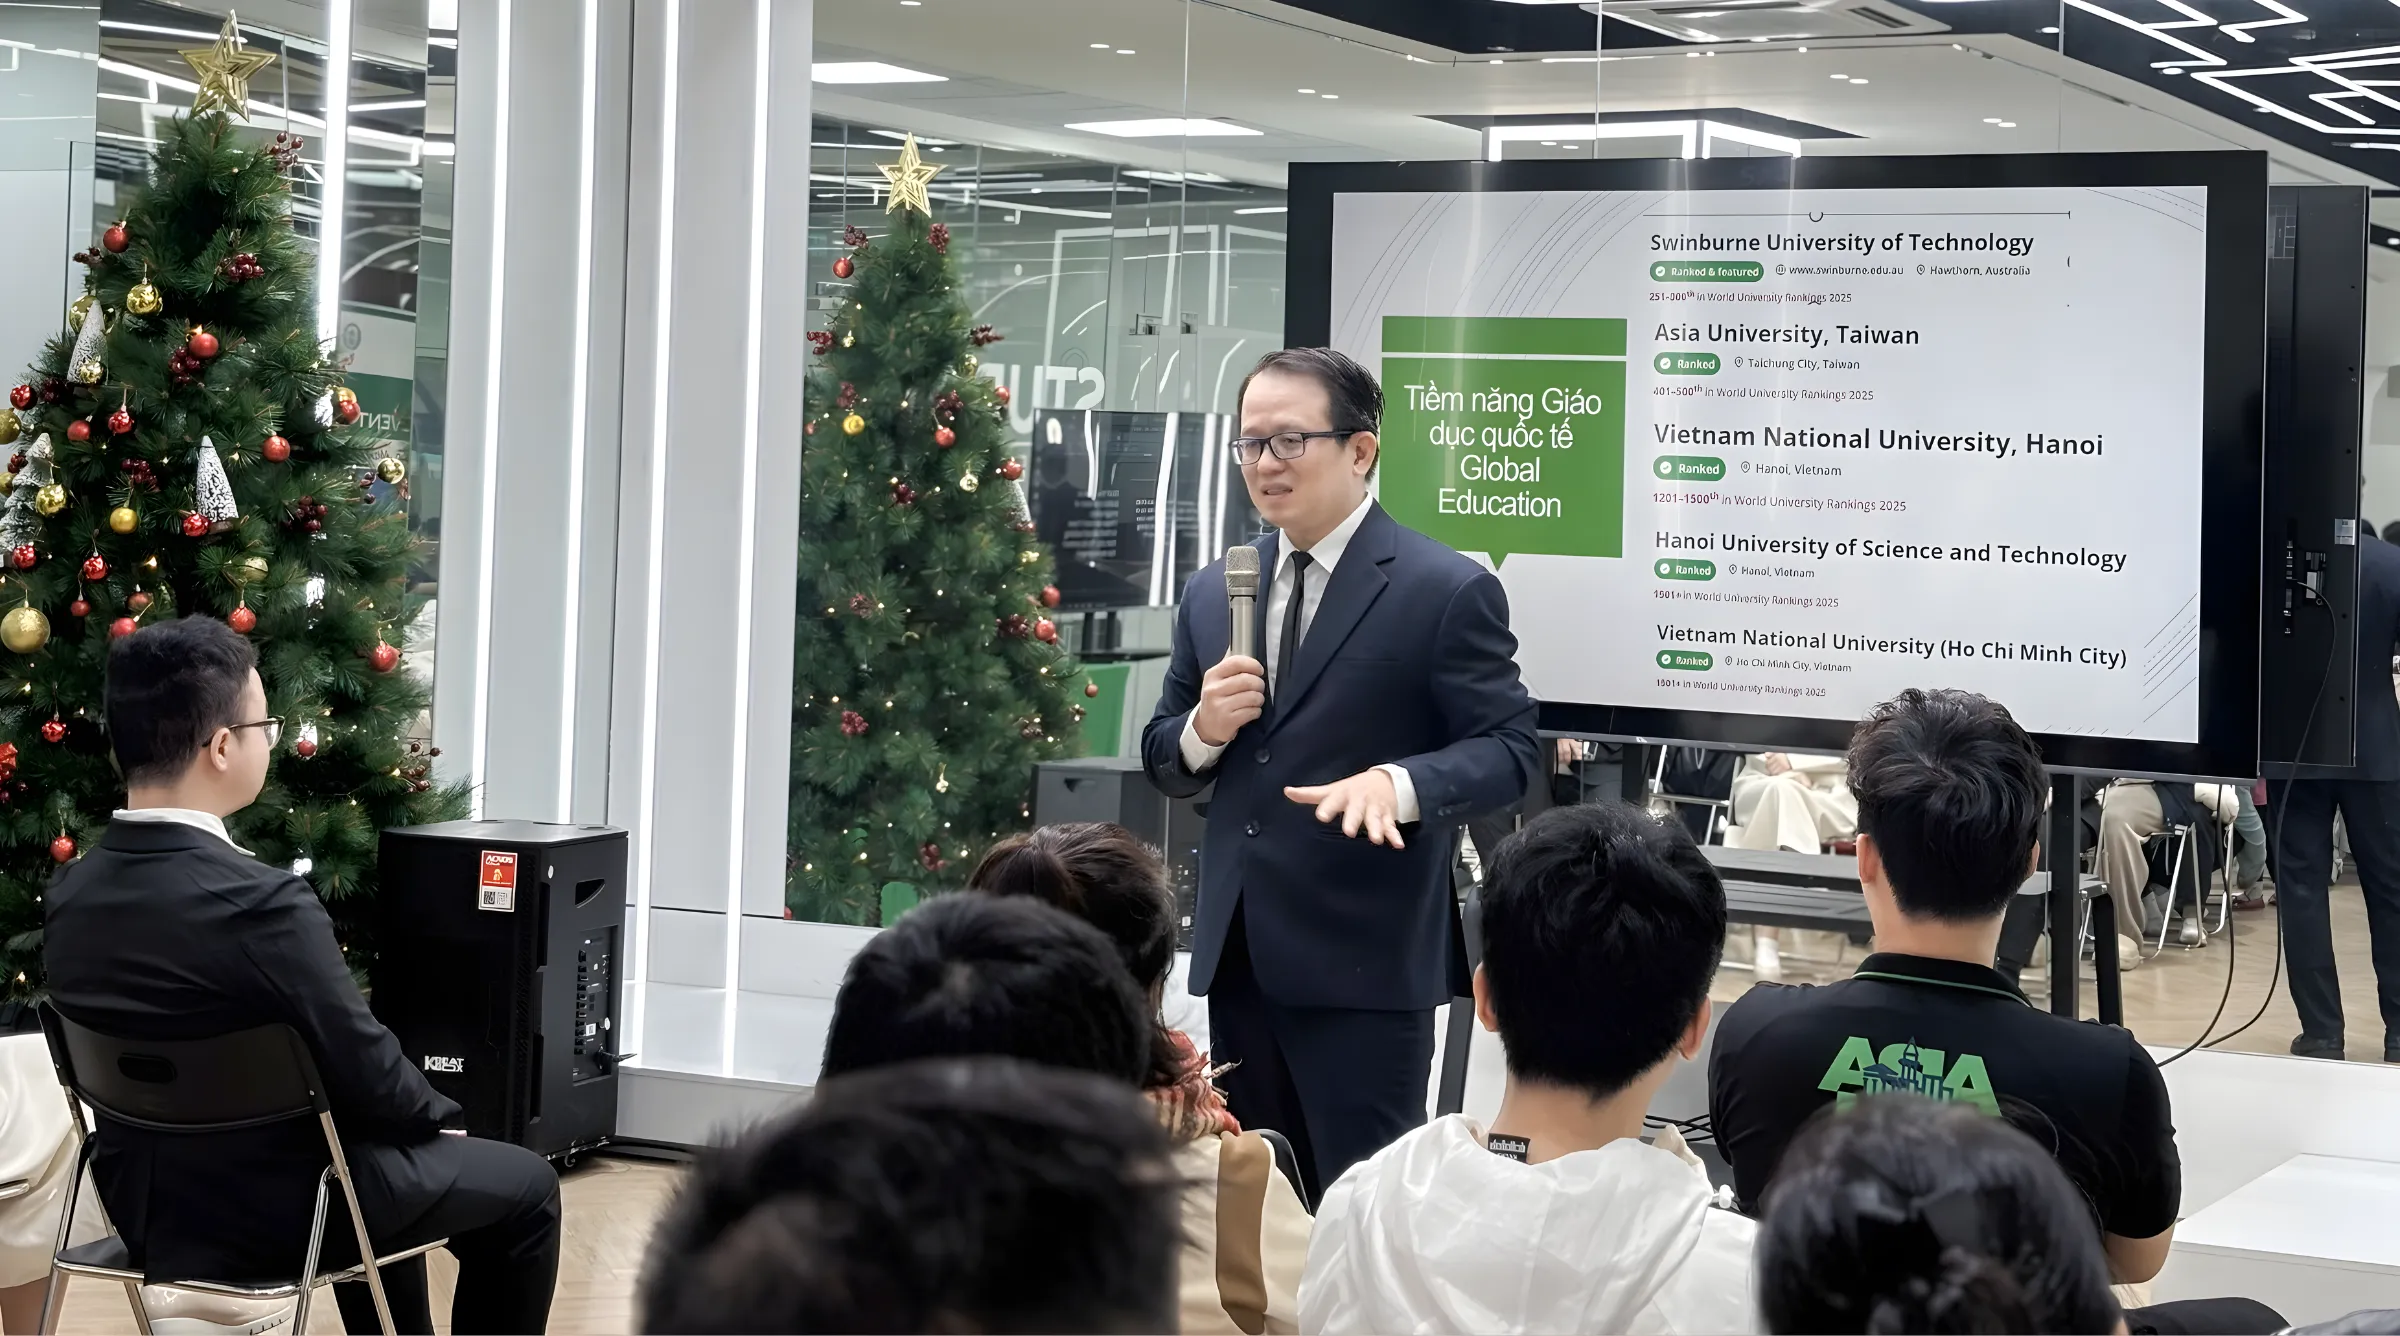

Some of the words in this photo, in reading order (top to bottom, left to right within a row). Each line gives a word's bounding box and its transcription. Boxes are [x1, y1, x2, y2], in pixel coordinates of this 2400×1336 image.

[1650, 233, 1761, 251] Swinburne
[1767, 232, 1876, 257] University
[1881, 232, 1905, 251] of
[1908, 232, 2035, 257] Technology
[1930, 265, 1983, 276] Hawthorn,
[1984, 265, 2031, 276] Australia
[1696, 292, 1706, 302] in
[1707, 292, 1735, 302] World
[1829, 293, 1852, 303] 2025
[1654, 322, 1700, 342] Asia
[1708, 323, 1829, 349] University,
[1835, 324, 1919, 345] Taiwan
[1677, 358, 1716, 370] Ranked
[1747, 357, 1795, 371] Taichung
[1797, 358, 1820, 372] City,
[1822, 358, 1860, 370] Taiwan
[1404, 380, 1463, 411] Tiềm
[1472, 386, 1534, 420] năng
[1542, 387, 1602, 415] Giáo
[1704, 386, 1714, 397] in
[1716, 387, 1746, 398] World
[1748, 388, 1799, 402] University
[1801, 389, 1846, 403] Rankings
[1848, 390, 1874, 401] 2025
[1430, 420, 1474, 449] dục
[1482, 415, 1543, 453] quốc
[1550, 417, 1573, 448] tế
[1653, 423, 1755, 446] Vietnam
[1764, 426, 1870, 449] National
[1879, 429, 2017, 459] University,
[2026, 433, 2103, 456] Hanoi
[1461, 455, 1539, 482] Global
[1678, 462, 1721, 476] Ranked
[1756, 463, 1791, 476] Hanoi,
[1794, 463, 1842, 476] Vietnam
[1439, 488, 1560, 517] Education
[1721, 494, 1732, 505] in
[1734, 495, 1767, 507] World
[1769, 496, 1824, 512] University
[1826, 498, 1876, 513] Rankings
[1879, 500, 1907, 512] 2025
[1656, 531, 1715, 550] Hanoi
[1722, 533, 1830, 560] University
[1835, 538, 1858, 556] of
[1862, 539, 1943, 560] Science
[1949, 543, 1990, 562] and
[1997, 545, 2127, 573] Technology
[1675, 564, 1712, 576] Ranked
[1741, 566, 1772, 577] Hanoi,
[1774, 567, 1815, 578] Vietnam
[1683, 590, 1692, 600] in
[1694, 592, 1721, 602] World
[1723, 593, 1770, 607] University
[1771, 595, 1813, 609] Rankings
[1815, 597, 1839, 608] 2025
[1656, 624, 1736, 644] Vietnam
[1743, 629, 1826, 649] National
[1833, 633, 1935, 660] University
[1940, 639, 1975, 659] (Ho
[1981, 641, 2014, 660] Chi
[2020, 644, 2072, 663] Minh
[2079, 647, 2127, 670] City)
[1817, 1035, 2003, 1117] ASIA
